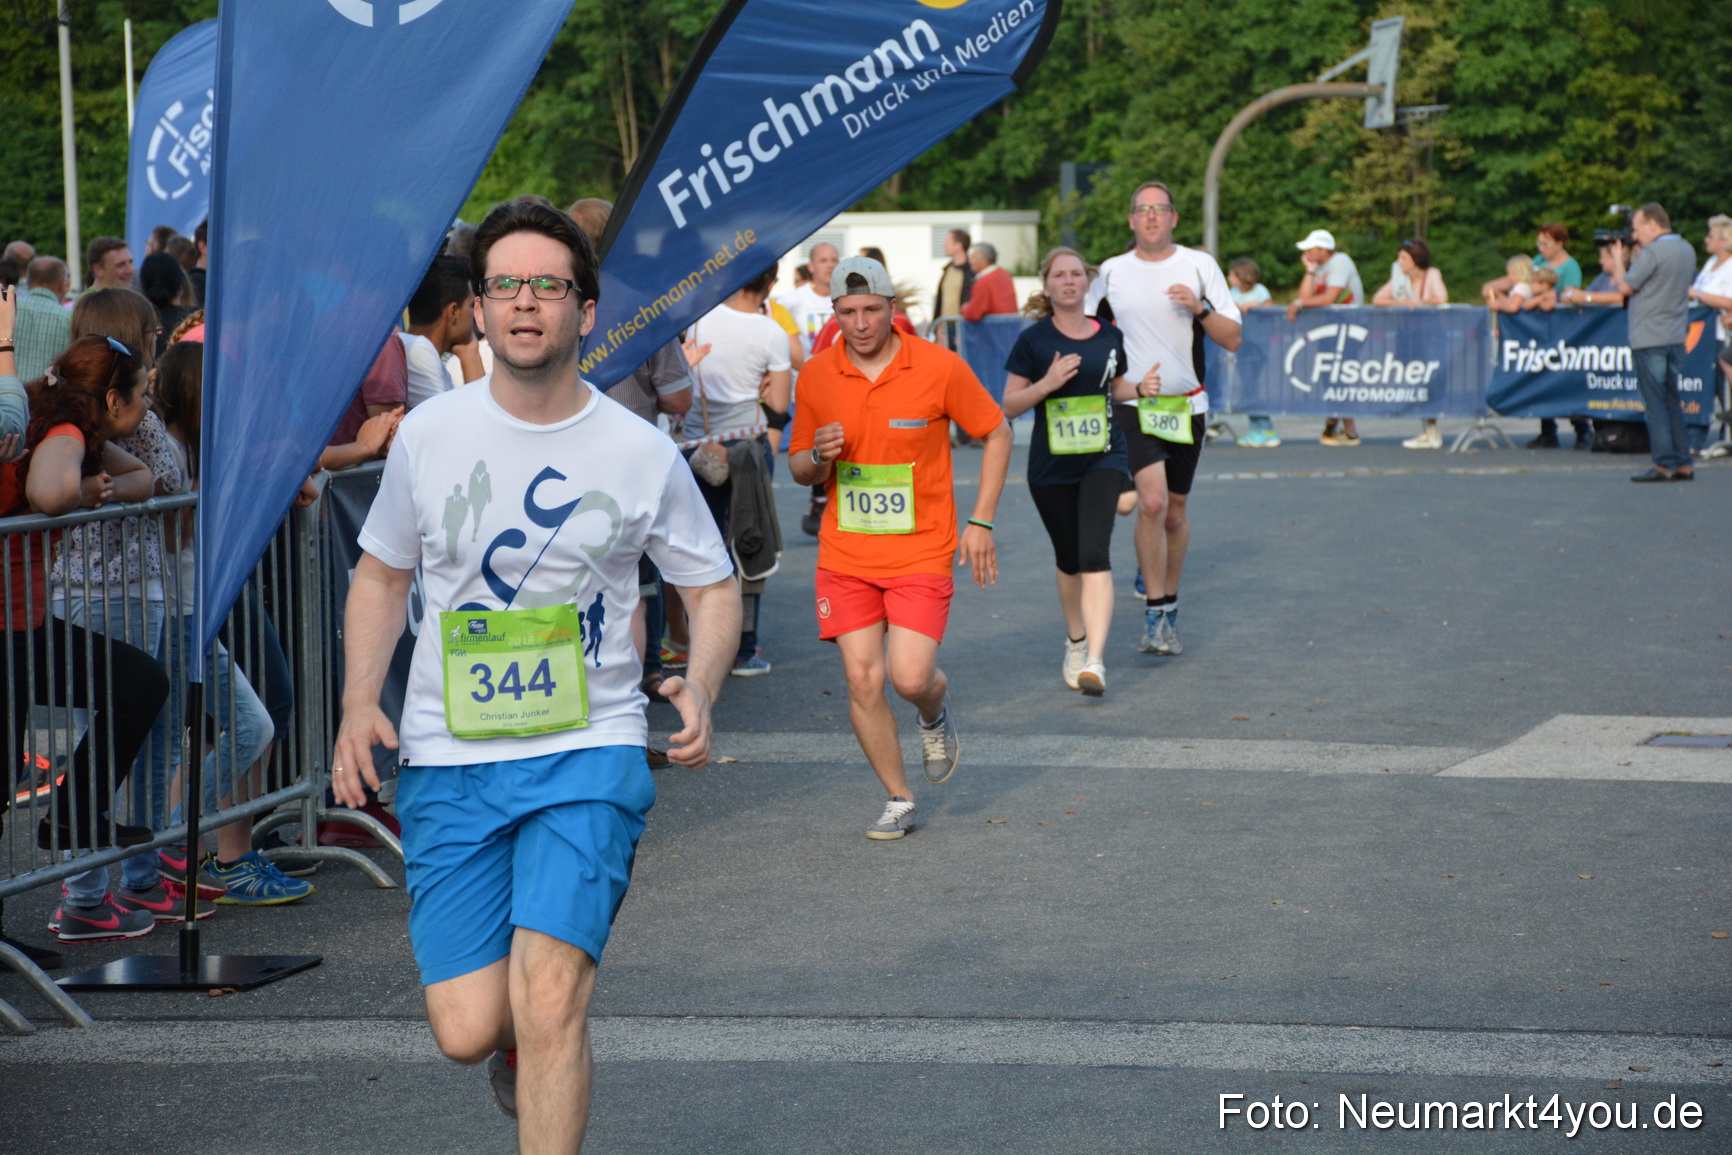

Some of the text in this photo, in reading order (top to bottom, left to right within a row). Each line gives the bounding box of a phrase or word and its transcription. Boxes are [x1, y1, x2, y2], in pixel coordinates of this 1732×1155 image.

[841, 0, 1035, 139] Druck und Medien
[168, 88, 213, 178] Fisc
[656, 18, 941, 229] Frischmann
[577, 228, 757, 374] ww.frischmann-net.de
[1311, 351, 1440, 385] Fischer
[1503, 339, 1633, 373] Frischman
[1322, 386, 1429, 402] AUTOMOBILE
[1586, 372, 1623, 390] Druck
[1055, 418, 1101, 438] 1149
[1148, 413, 1179, 431] 380
[845, 490, 905, 514] 1039
[460, 631, 506, 643] firmenlauf
[469, 658, 557, 703] 344
[480, 708, 551, 721] Christian Junker
